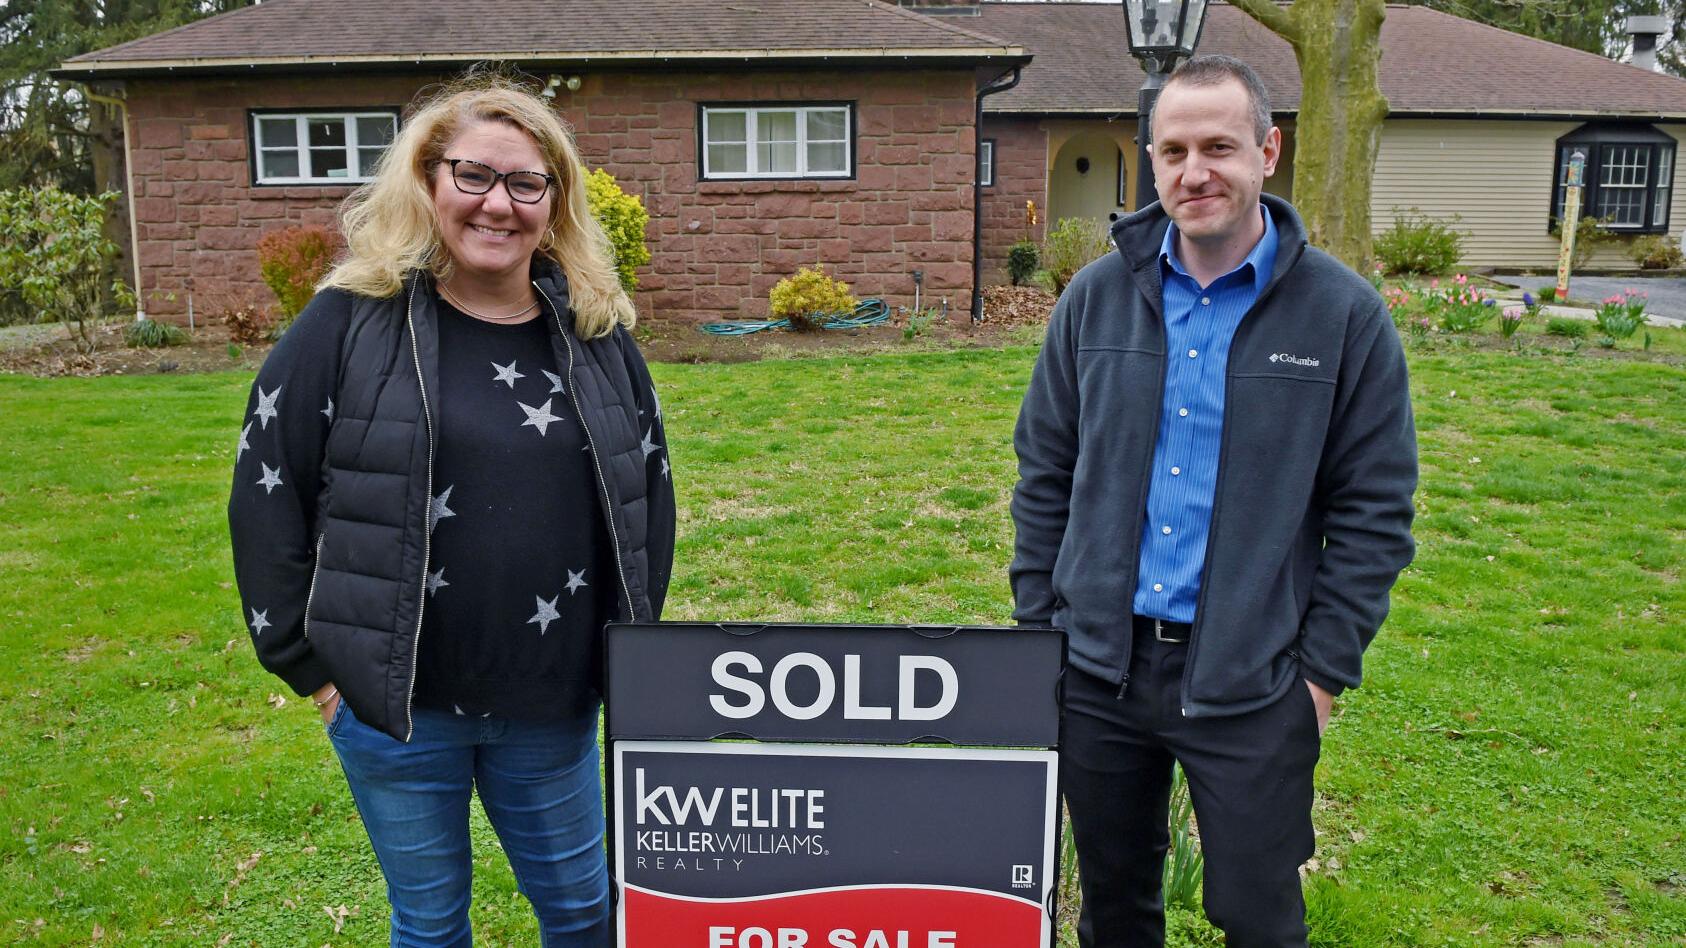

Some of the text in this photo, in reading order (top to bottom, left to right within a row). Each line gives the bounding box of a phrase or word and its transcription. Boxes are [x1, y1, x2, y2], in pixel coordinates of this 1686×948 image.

[1280, 353, 1320, 367] Columbia
[709, 650, 959, 721] SOLD
[731, 787, 825, 829] ELITE
[637, 856, 744, 872] REALTY
[709, 926, 809, 948] FOR
